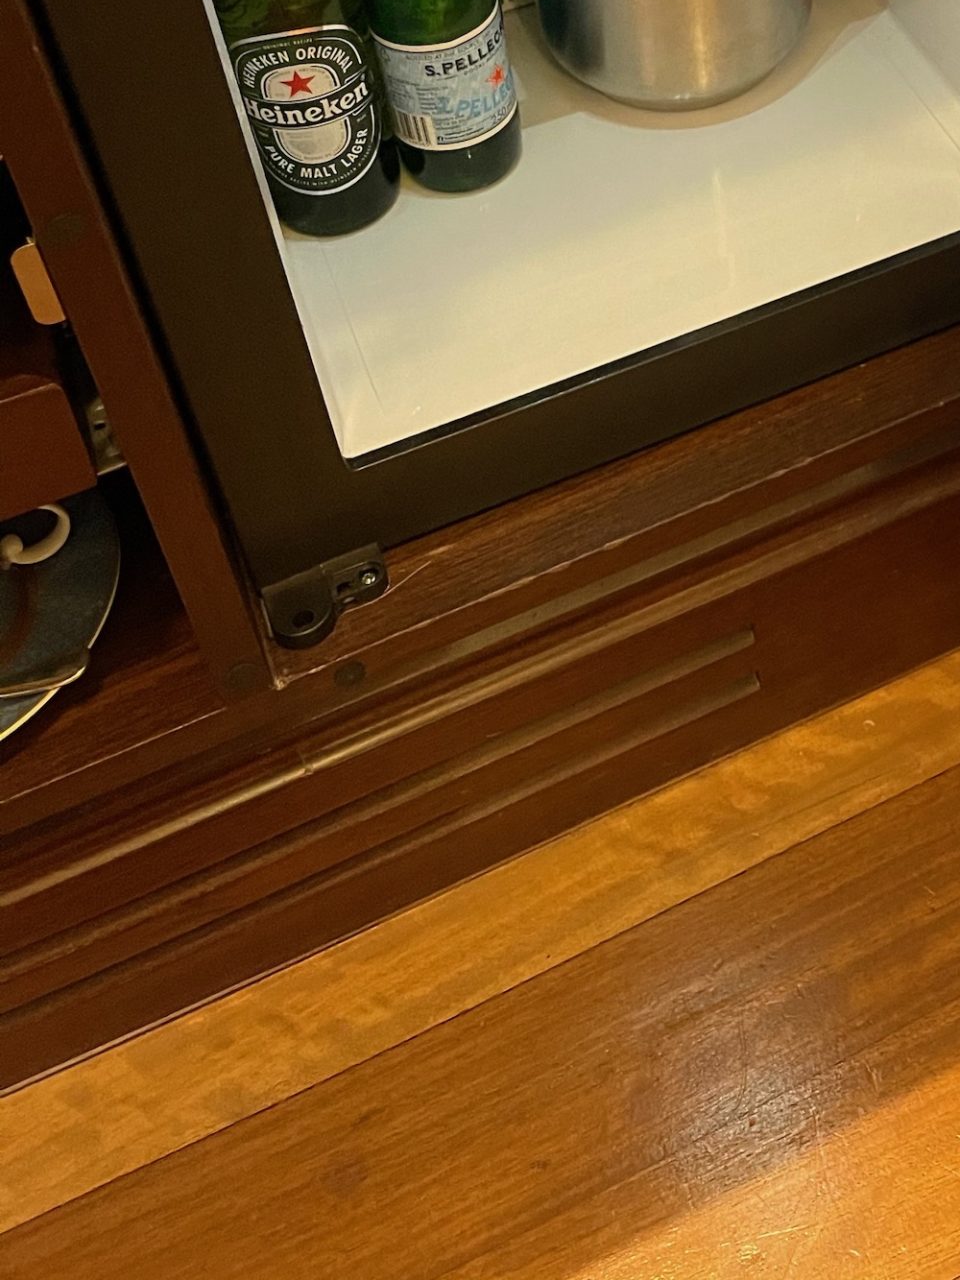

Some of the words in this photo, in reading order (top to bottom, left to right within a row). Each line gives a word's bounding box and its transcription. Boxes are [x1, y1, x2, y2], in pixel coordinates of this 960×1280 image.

[242, 50, 290, 89] HEINEKEN
[295, 45, 353, 74] ORIGINAL
[243, 81, 369, 125] Heineken
[264, 144, 296, 174] PURE
[300, 163, 339, 179] MALT
[340, 128, 368, 168] LAGER
